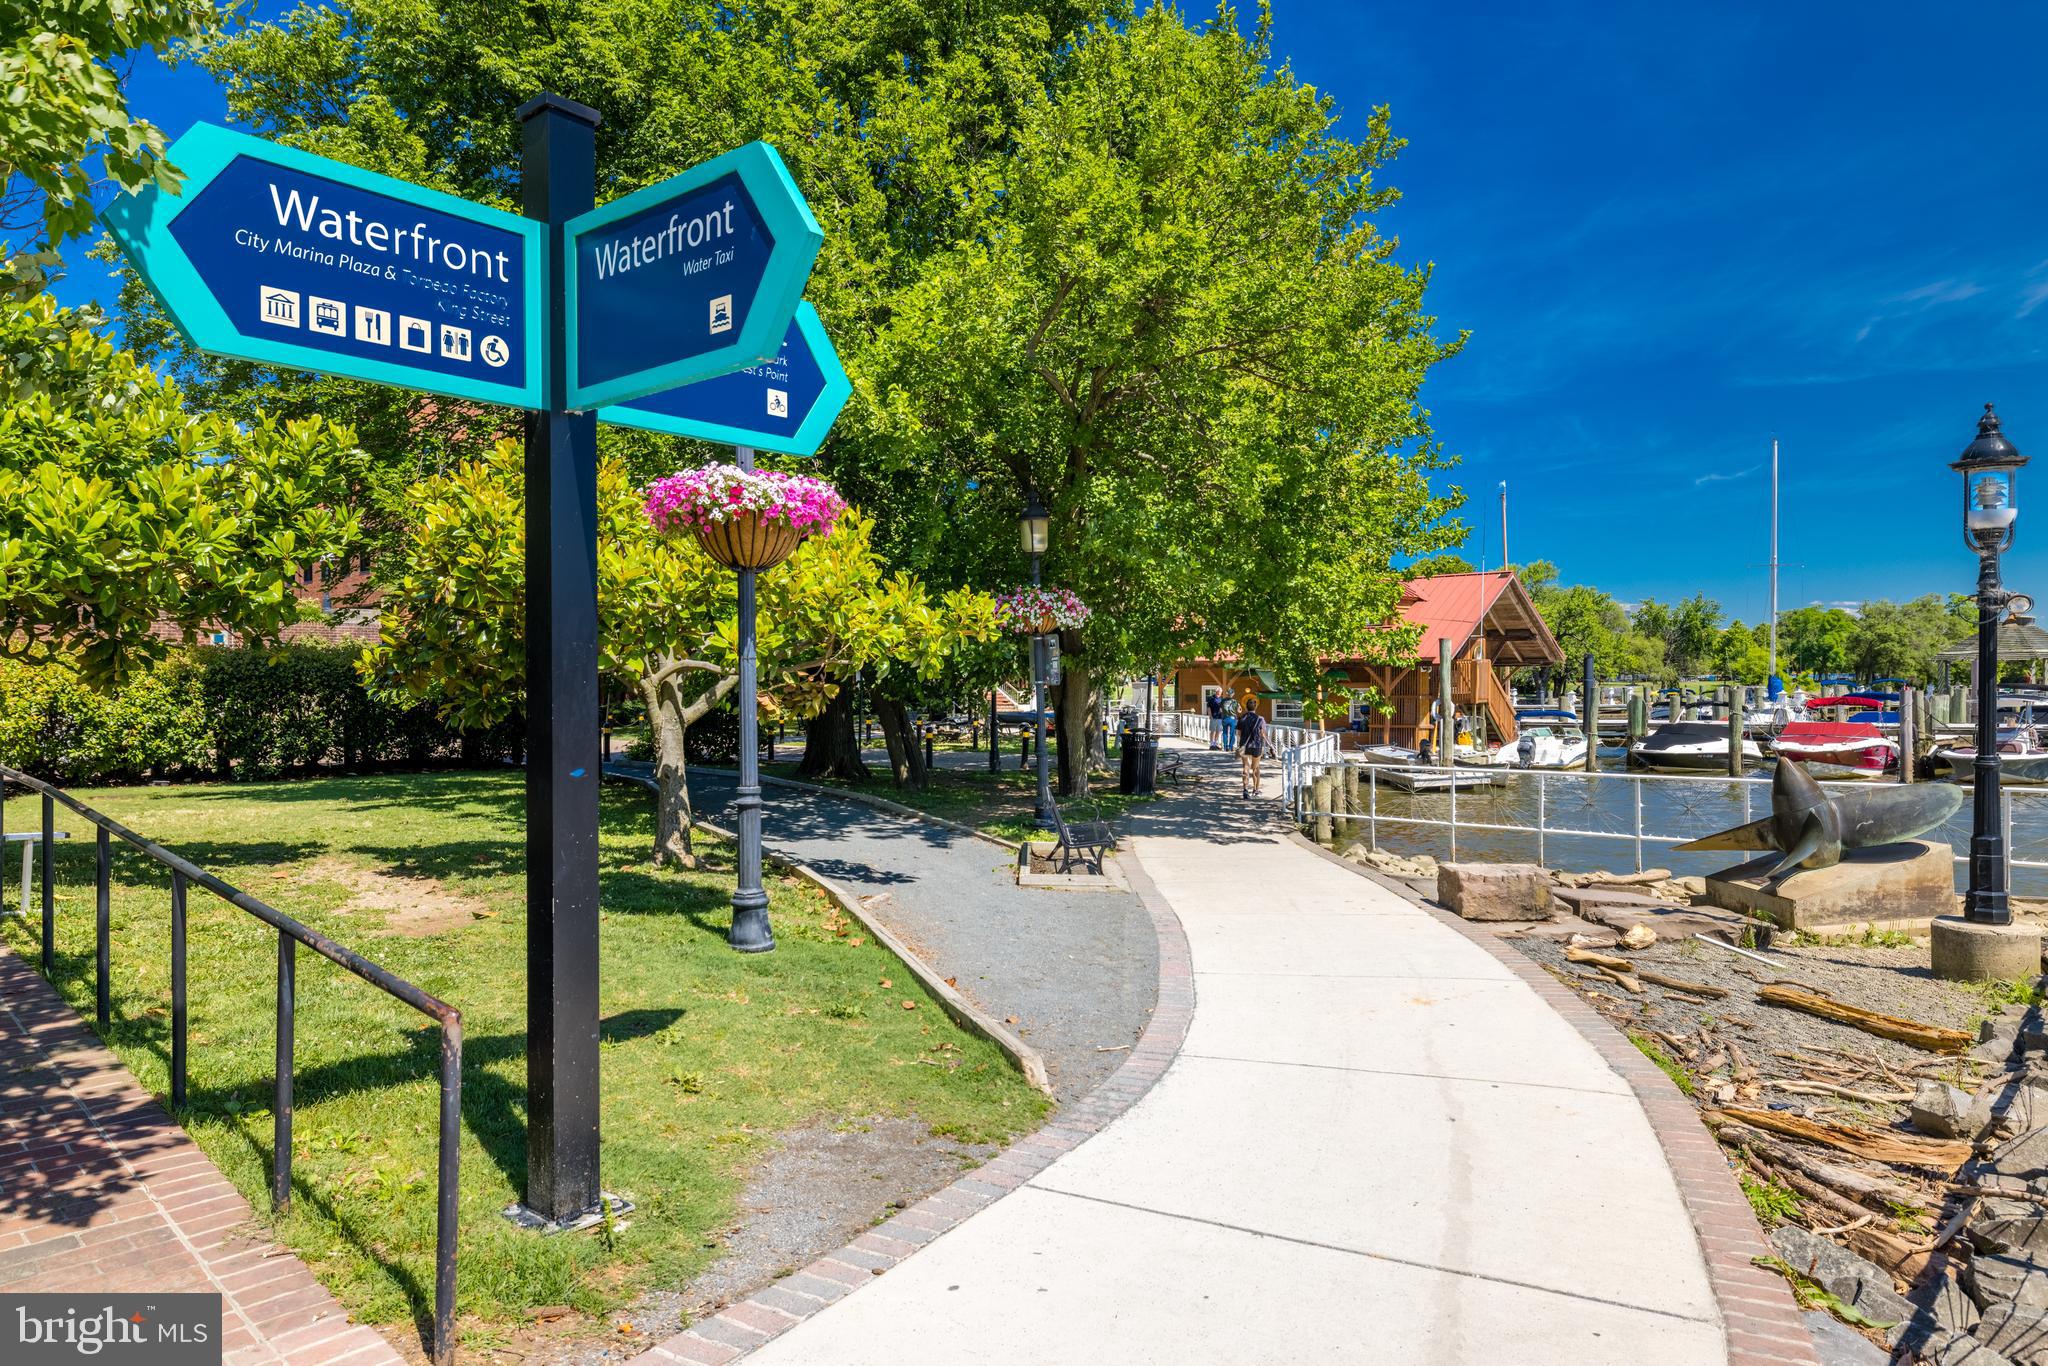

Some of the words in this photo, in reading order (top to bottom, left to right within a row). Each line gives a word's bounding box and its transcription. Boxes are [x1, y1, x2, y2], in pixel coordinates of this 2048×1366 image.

[269, 183, 509, 282] Waterfront
[595, 200, 735, 280] Waterfront
[235, 229, 269, 252] City
[274, 238, 333, 266] Marina
[339, 253, 380, 276] Plaza
[384, 265, 396, 280] &
[683, 257, 712, 276] Water
[715, 246, 735, 266] Taxi
[437, 300, 467, 320] Kng
[765, 367, 788, 382] Point
